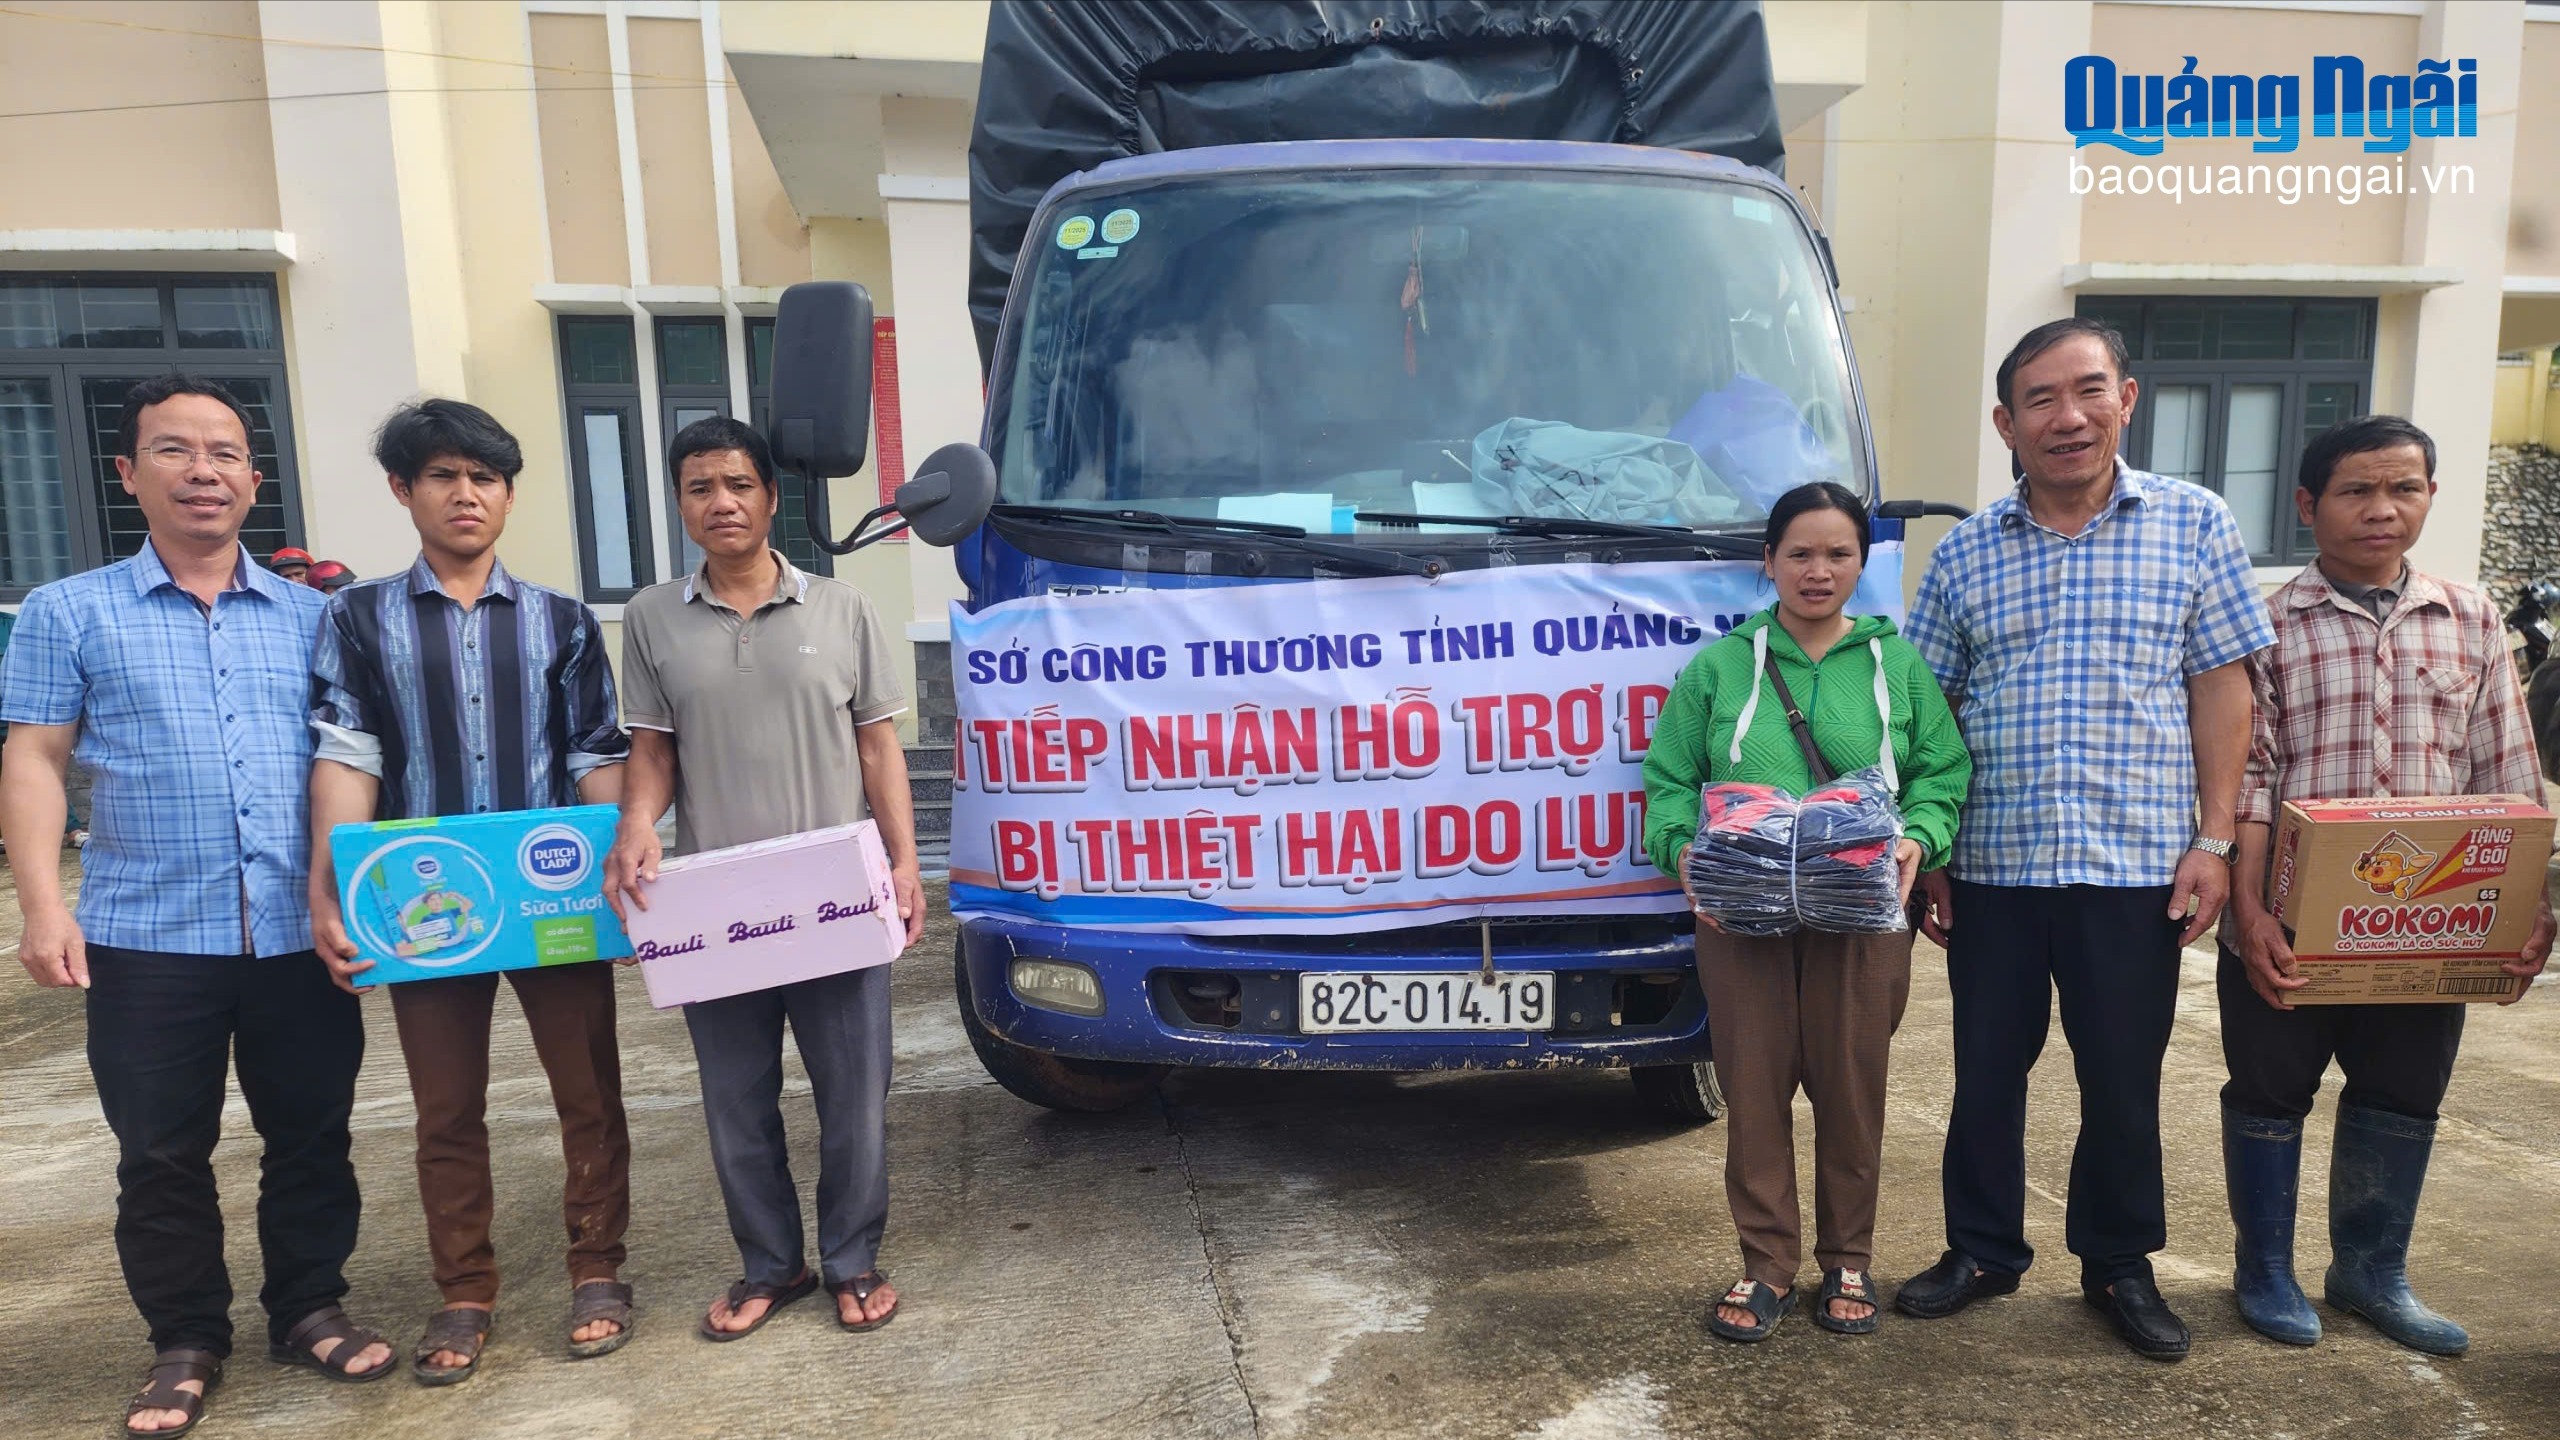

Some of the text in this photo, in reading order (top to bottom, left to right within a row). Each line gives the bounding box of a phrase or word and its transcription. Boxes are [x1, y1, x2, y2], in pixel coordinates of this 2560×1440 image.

[968, 637, 1029, 685] SỞ
[1042, 642, 1167, 683] CÔNG
[1184, 633, 1382, 678] THƯƠNG
[1400, 614, 1515, 664] TỈNH
[1533, 602, 1701, 656] QUẢNG
[972, 703, 1109, 784] TIẾP
[1128, 702, 1320, 786] NHẬN
[1341, 686, 1441, 772] HỖ
[1462, 683, 1605, 766] TRỢ
[1623, 684, 1671, 754] Đ
[2368, 810, 2412, 819] TÔM
[2413, 808, 2467, 817] CHUA
[2470, 806, 2508, 815] CAY
[996, 818, 1060, 893] BỊ
[1074, 808, 1262, 890] THIỆT
[1285, 807, 1402, 884] HẠI
[1424, 800, 1521, 868] DO
[2470, 825, 2513, 847] TẶNG
[534, 847, 577, 860] DUTCH
[540, 859, 573, 870] LADY
[2463, 845, 2507, 866] 3 GÓI
[520, 893, 603, 916] Sữa Tươi
[2479, 889, 2497, 900] 65
[728, 915, 796, 943] Bauli
[2338, 903, 2497, 938] KOKOMI
[638, 935, 705, 961] Bauli
[2336, 936, 2484, 950] CÓ KOKOMI LÀ CÓ SỨC HÚT
[1312, 980, 1544, 1025] 82C-014.19
